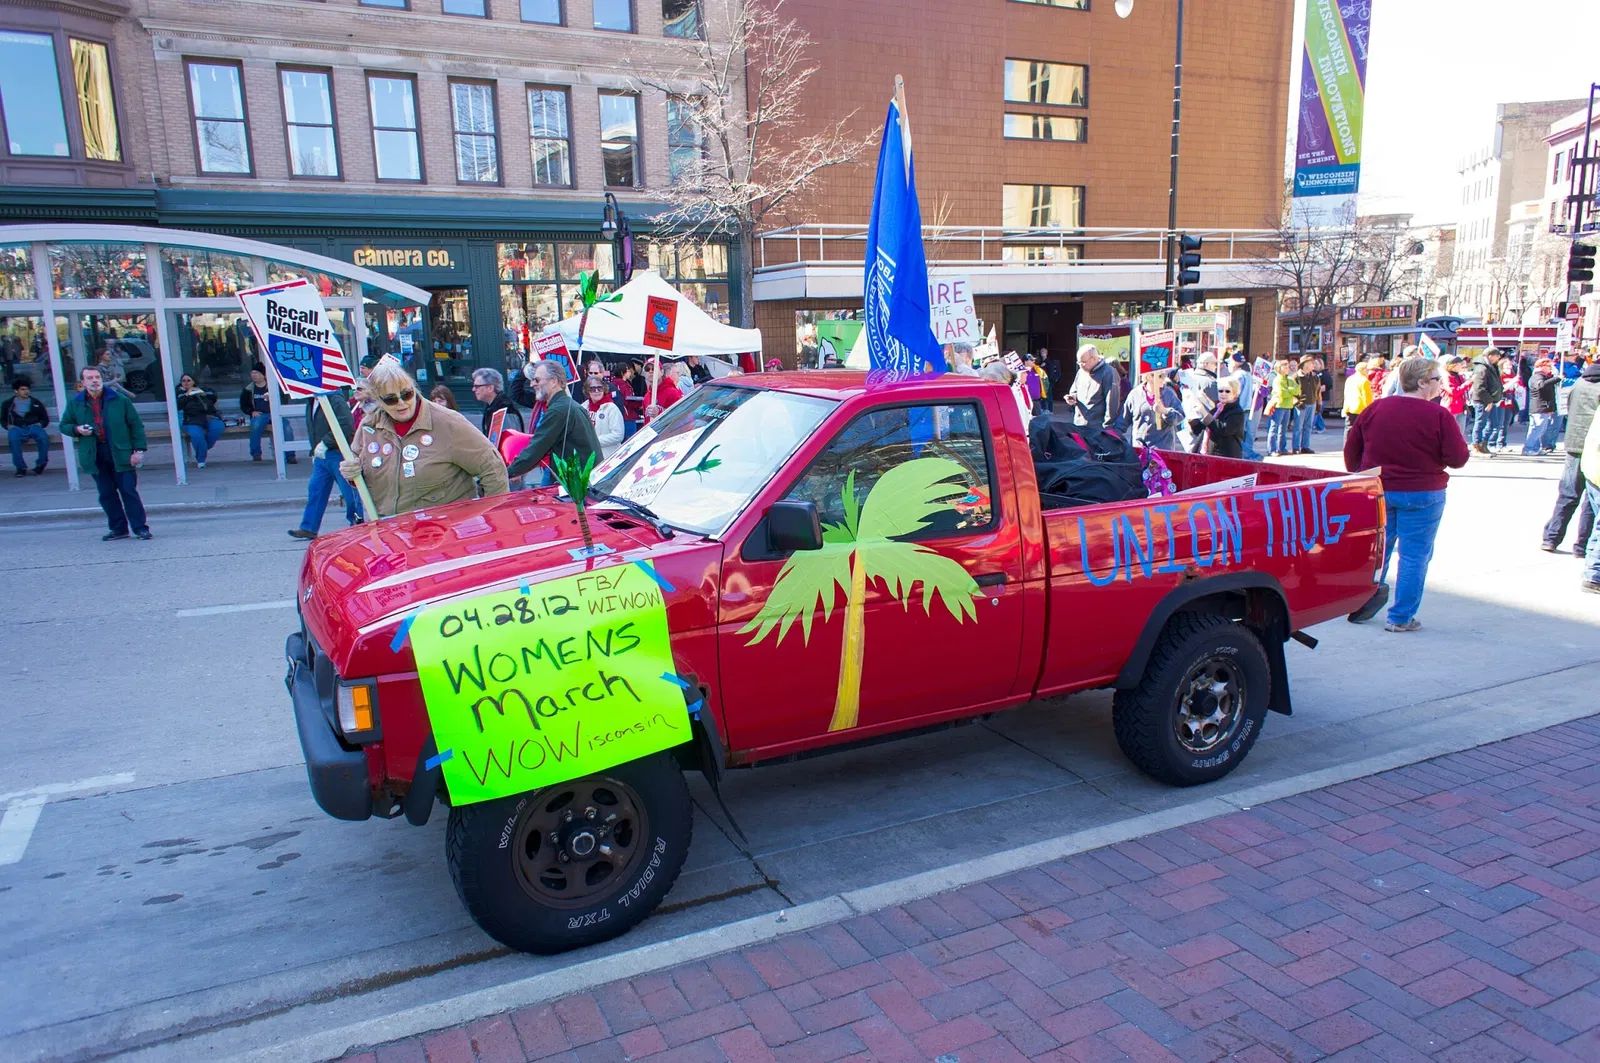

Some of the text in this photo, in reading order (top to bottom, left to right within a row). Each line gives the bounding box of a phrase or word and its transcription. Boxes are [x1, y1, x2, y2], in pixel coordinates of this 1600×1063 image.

[1319, 55, 1357, 157] INNOVATIONS
[1307, 155, 1336, 165] EXHIBIT
[1305, 178, 1355, 187] INNOVATIONS
[1308, 171, 1355, 180] WISCONSIN
[353, 249, 423, 267] camera
[929, 281, 967, 306] IRE
[266, 298, 319, 327] Recall
[931, 305, 952, 317] THE
[1362, 306, 1392, 319] FIB'S
[266, 314, 330, 344] Walker!
[935, 318, 970, 339] IAR
[534, 335, 562, 351] Reclaim
[1077, 482, 1350, 587] UNION THUG
[440, 595, 580, 638] 04.28.12
[442, 622, 642, 695] WOMENS
[471, 670, 642, 733] March
[1191, 719, 1255, 768] WILD SPIRIT
[567, 836, 667, 930] RADIAL TXR
